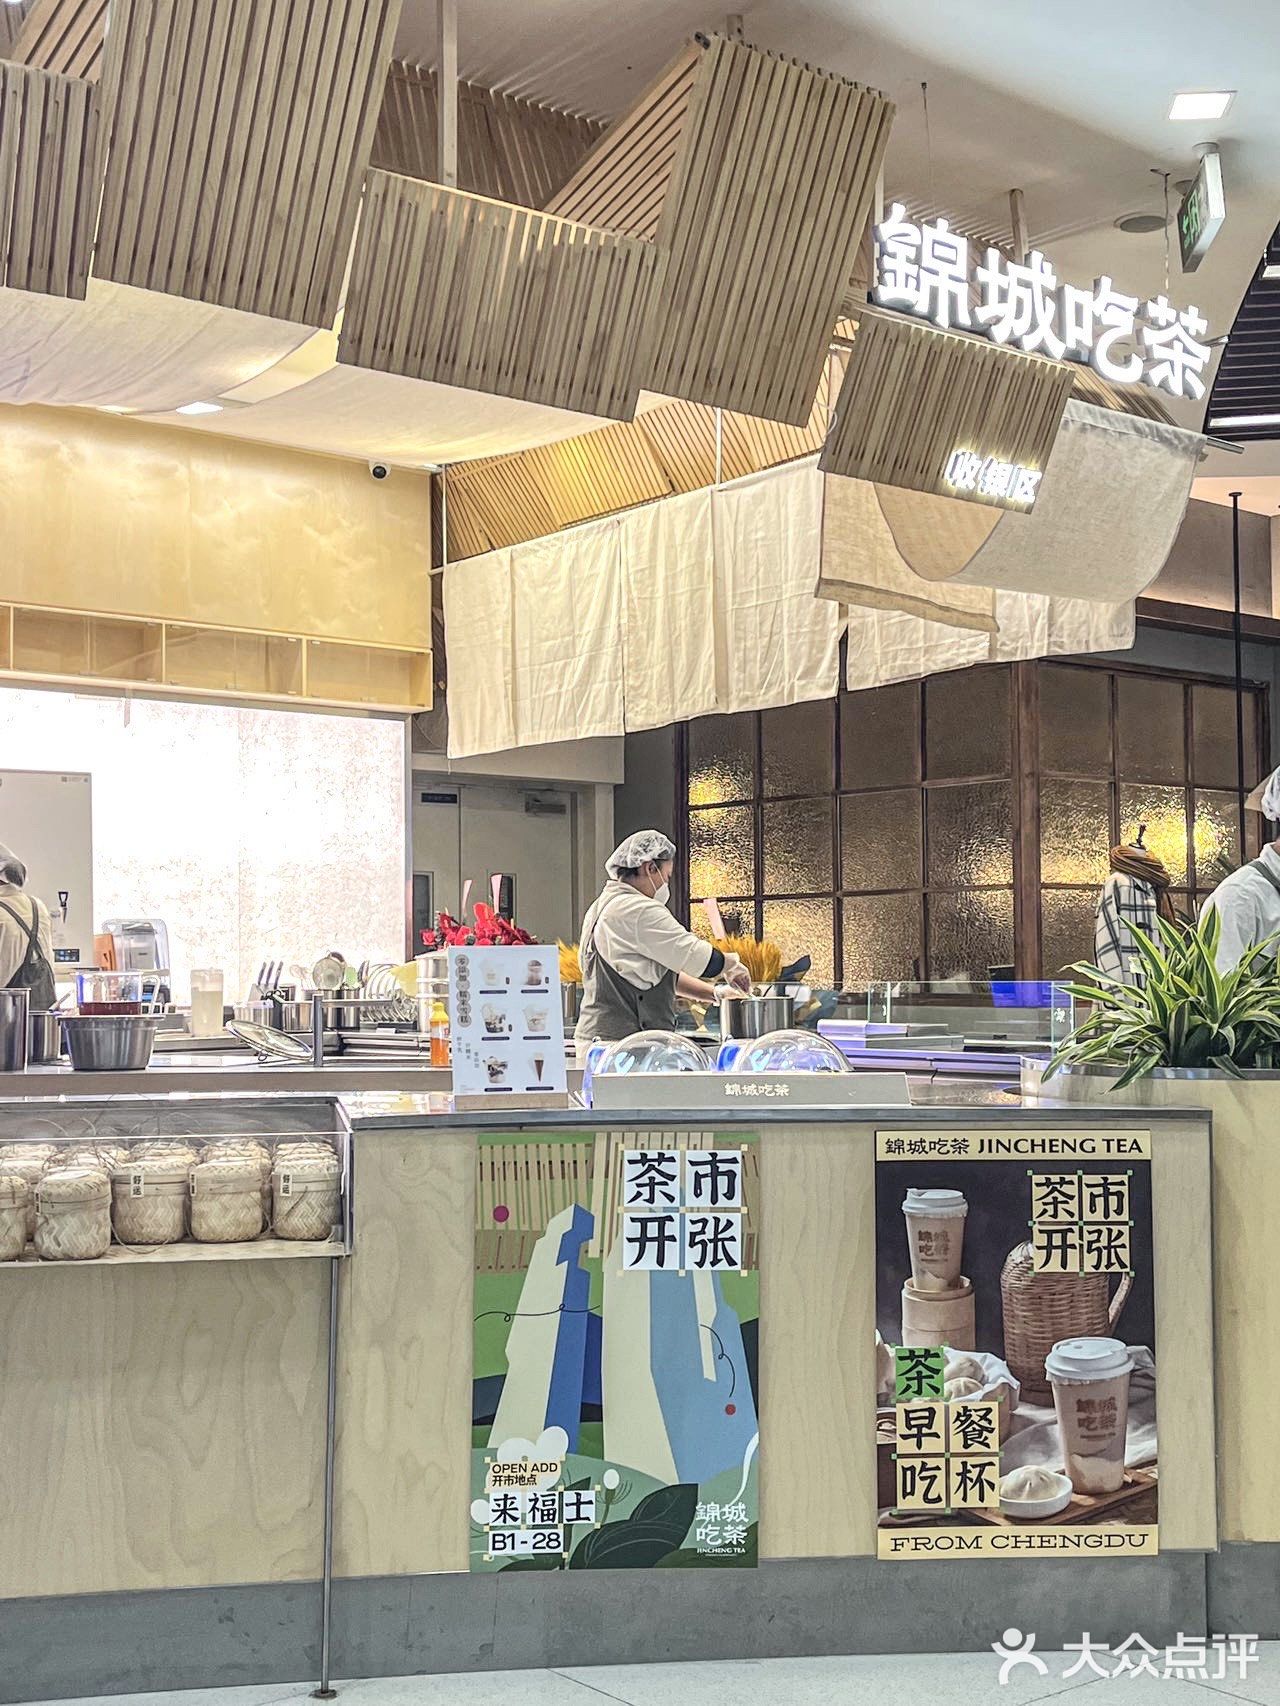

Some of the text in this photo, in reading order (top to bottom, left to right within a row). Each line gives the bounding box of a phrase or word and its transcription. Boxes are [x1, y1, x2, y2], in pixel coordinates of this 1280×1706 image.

[873, 202, 1212, 399] 錦城吃茶
[724, 1083, 790, 1096] 錦城吃茶
[885, 1138, 1144, 1156] 錦城吃茶 JINCHENG TEA
[627, 1152, 741, 1206] 茶市
[1033, 1175, 1127, 1221] 茶市
[626, 1215, 738, 1269] 开张
[1036, 1226, 1129, 1271] 开张
[897, 1348, 942, 1397] 茶
[899, 1405, 997, 1452] 早餐
[492, 1462, 558, 1474] OPEN ADD
[492, 1474, 538, 1487] 开市地点
[901, 1459, 997, 1505] 吃杯
[491, 1492, 594, 1524] 来福士
[695, 1501, 749, 1522] 錦城
[696, 1524, 748, 1545] 吃茶
[890, 1533, 1149, 1552] FROM CHENGDU
